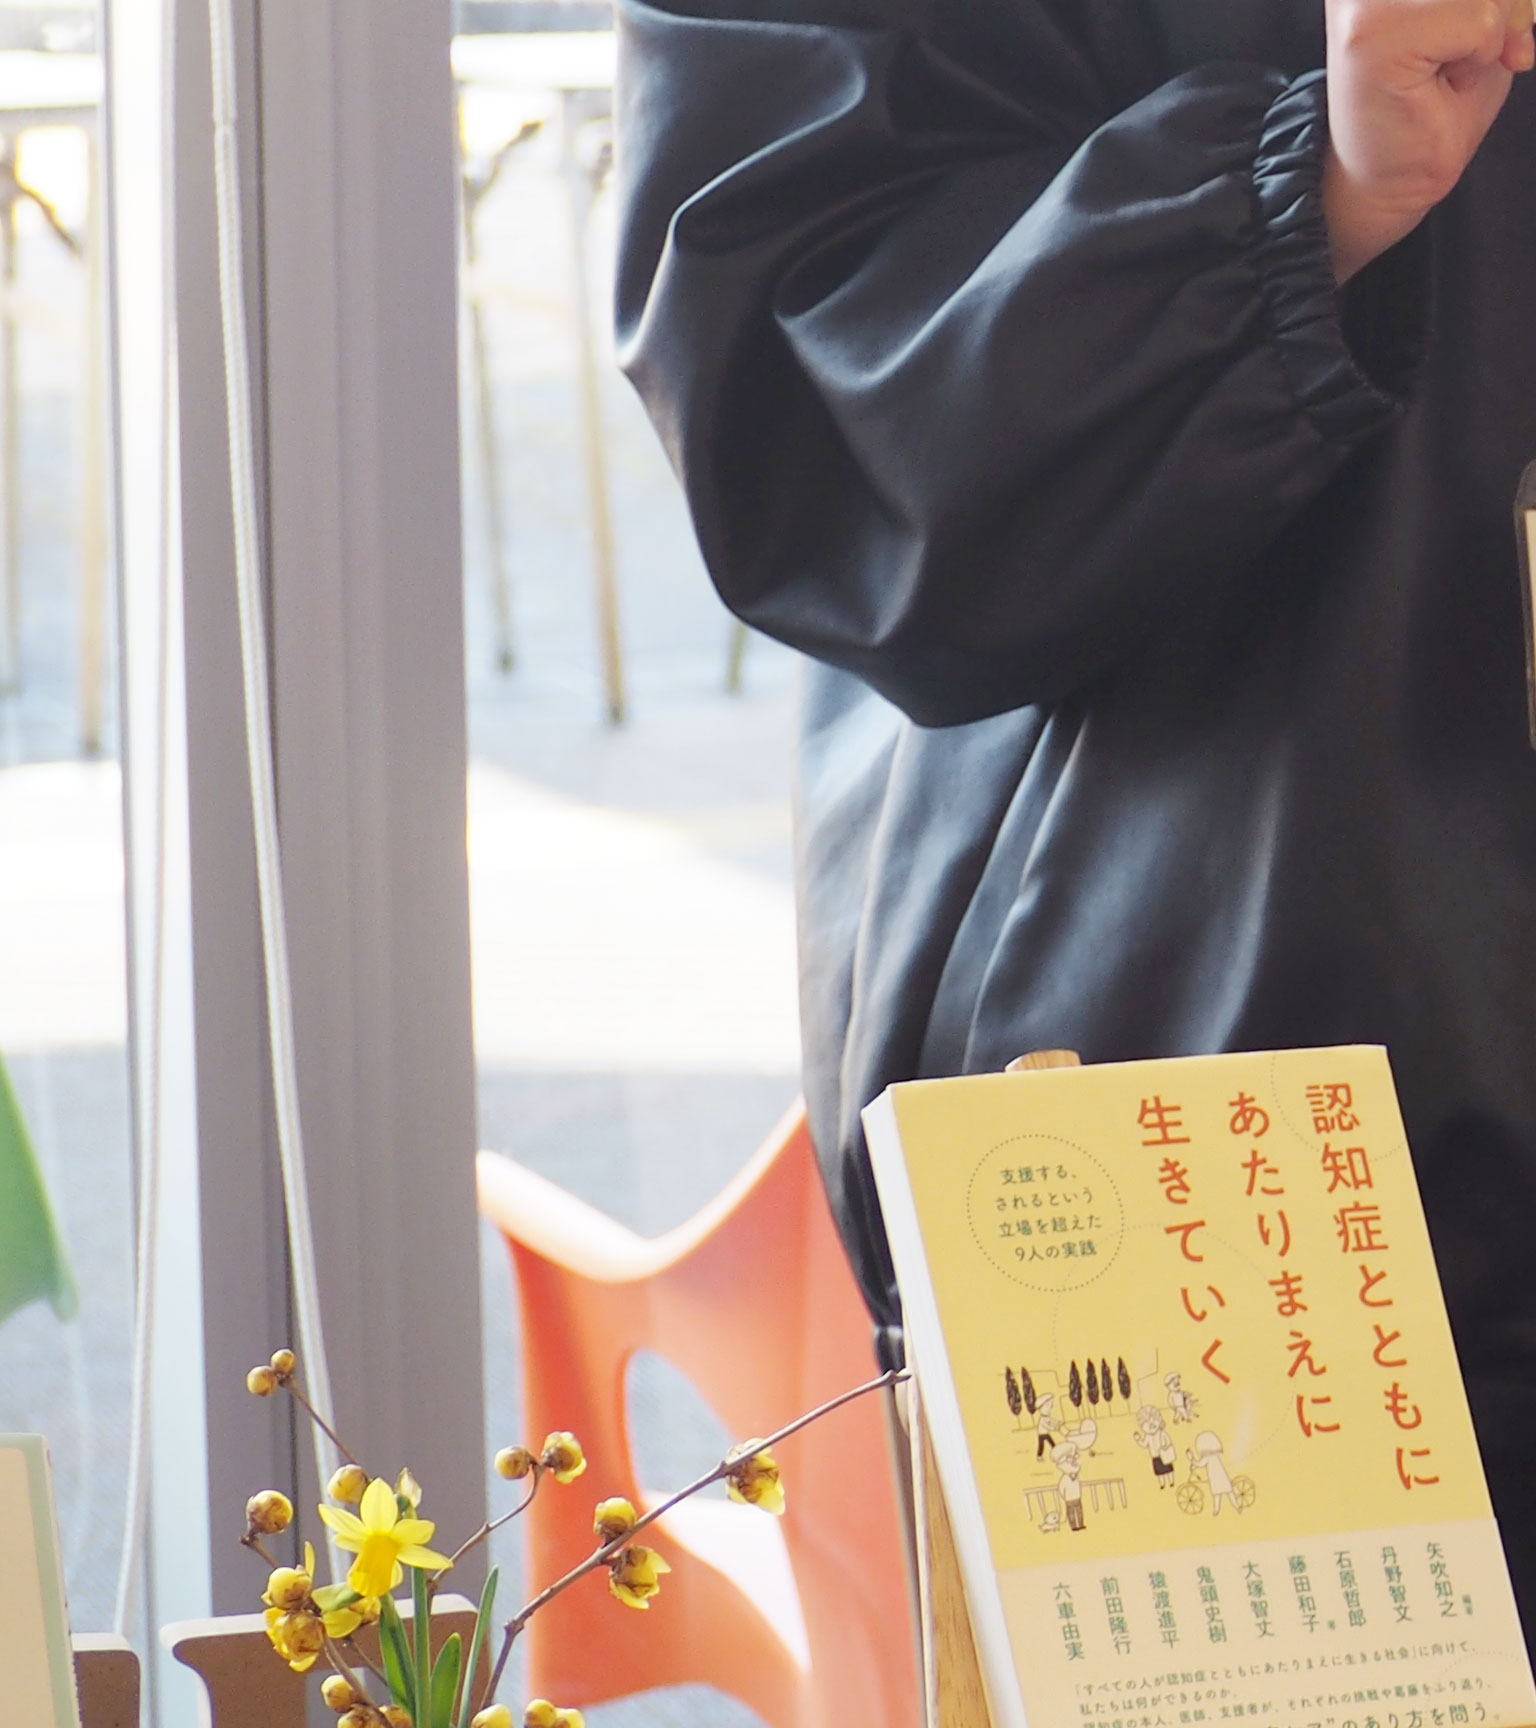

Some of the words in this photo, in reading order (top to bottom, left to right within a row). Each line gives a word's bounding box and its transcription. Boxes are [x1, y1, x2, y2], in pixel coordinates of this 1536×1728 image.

[995, 1186, 1093, 1211] されるという
[1000, 1164, 1077, 1185] 支援する、
[999, 1214, 1103, 1238] 立場を超えた
[1136, 1095, 1232, 1385] 生きていく
[1227, 1091, 1341, 1438] あたりまえに
[1305, 1082, 1440, 1491] 認知症とともに
[1100, 1575, 1133, 1657] 前田隆行
[1196, 1564, 1229, 1645] 鬼頭史樹
[1242, 1559, 1275, 1640] 大塚智丈
[1288, 1554, 1321, 1634] 藤田和子
[1334, 1549, 1368, 1629] 石原哲郎
[1381, 1544, 1414, 1625] 丹野智文
[1425, 1540, 1458, 1619] 矢吹知之
[1052, 1580, 1086, 1663] 六車由実
